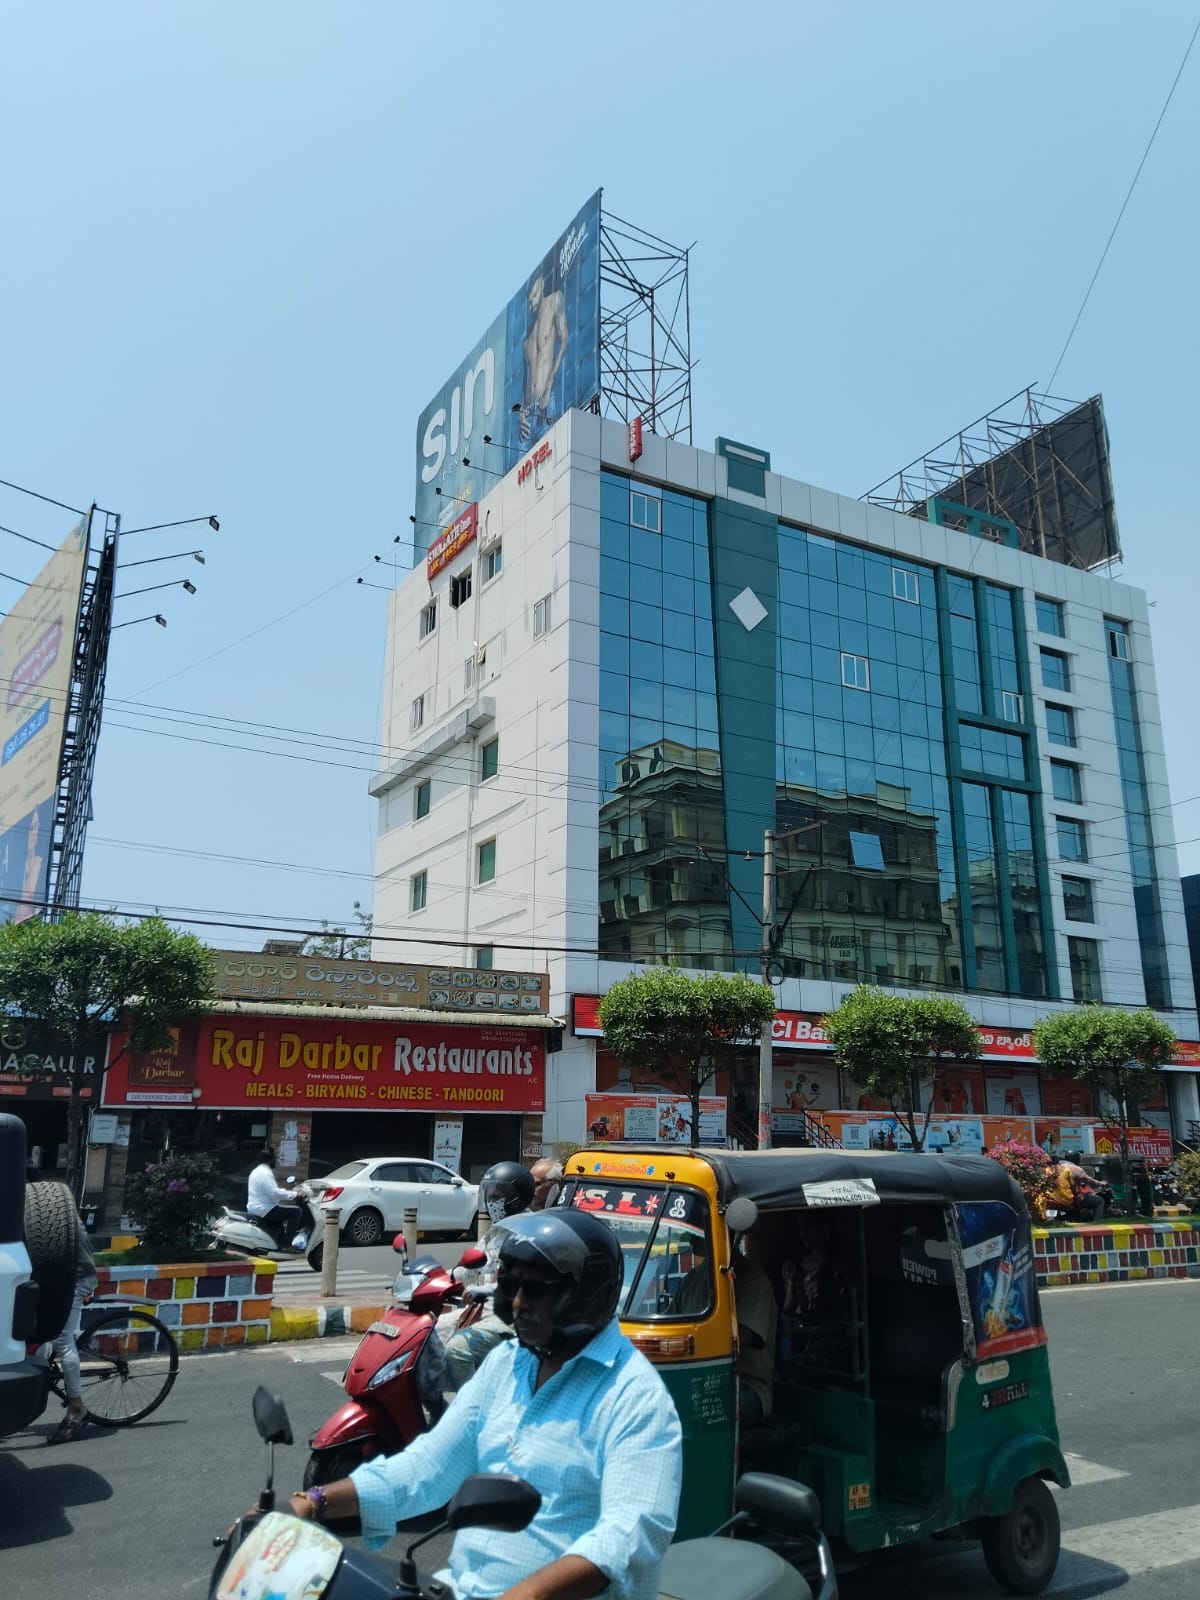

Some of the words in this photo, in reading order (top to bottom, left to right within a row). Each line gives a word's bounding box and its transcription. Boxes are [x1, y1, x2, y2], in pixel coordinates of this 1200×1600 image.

[422, 348, 494, 483] sin
[518, 441, 552, 485] HOTEL
[142, 1066, 184, 1079] Darbar
[211, 1029, 265, 1076] Raj
[280, 1033, 382, 1072] Darbar
[394, 1037, 533, 1076] Restaurants
[246, 1082, 294, 1097] MEALS
[305, 1083, 367, 1098] BIRYANIS
[378, 1085, 432, 1100] CHINESE
[443, 1087, 504, 1102] TANDOORI
